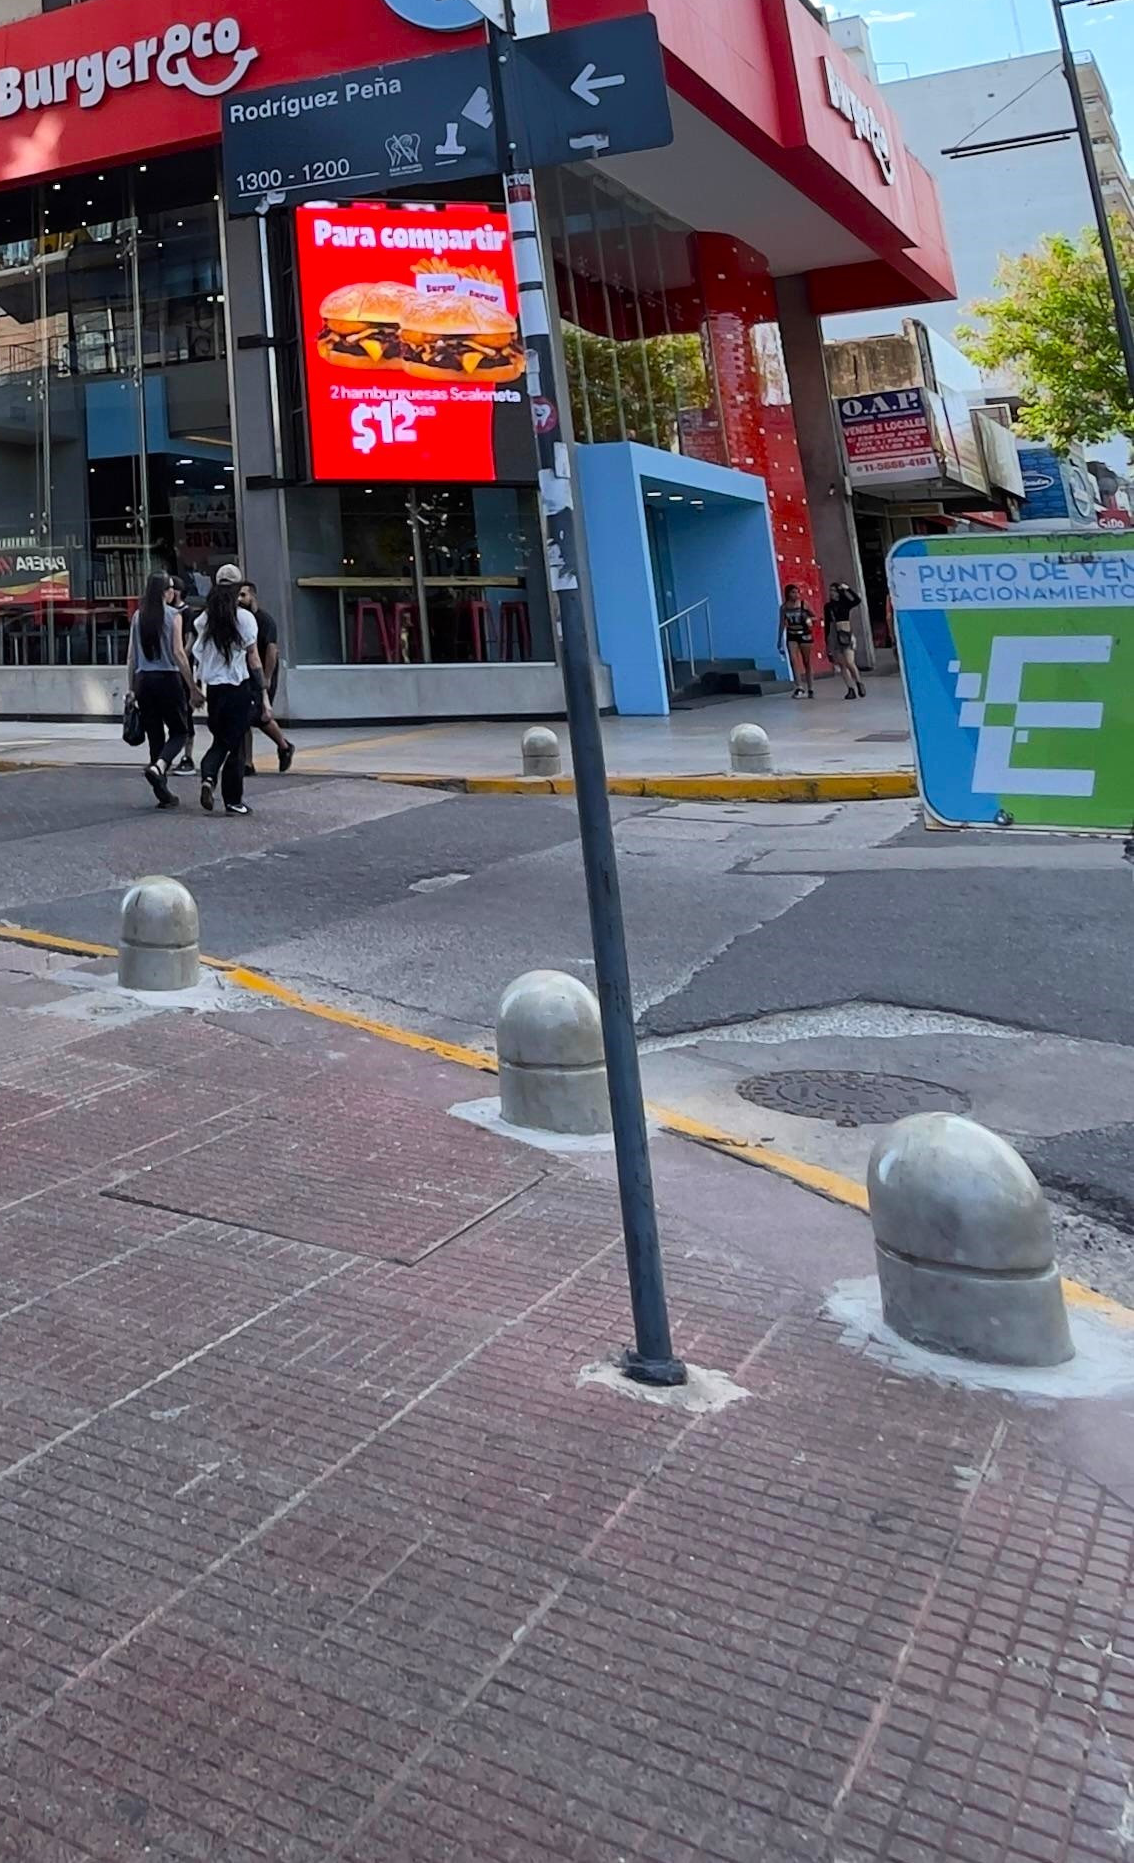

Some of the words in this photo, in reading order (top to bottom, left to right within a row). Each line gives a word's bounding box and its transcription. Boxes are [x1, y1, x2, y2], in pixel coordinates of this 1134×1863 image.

[230, 89, 339, 124] Rodríguez
[345, 77, 402, 103] Peña
[236, 169, 282, 192] 1300
[303, 159, 350, 183] 1200
[313, 219, 377, 247] Para
[380, 223, 507, 255] compartir
[330, 385, 341, 399] 2
[341, 386, 448, 402] hamburguesas
[450, 386, 522, 403] Scaloneta
[841, 392, 919, 417] O.A.P.
[351, 399, 417, 454] $12
[918, 563, 1018, 584] PUNTO
[1029, 561, 1070, 581] DE
